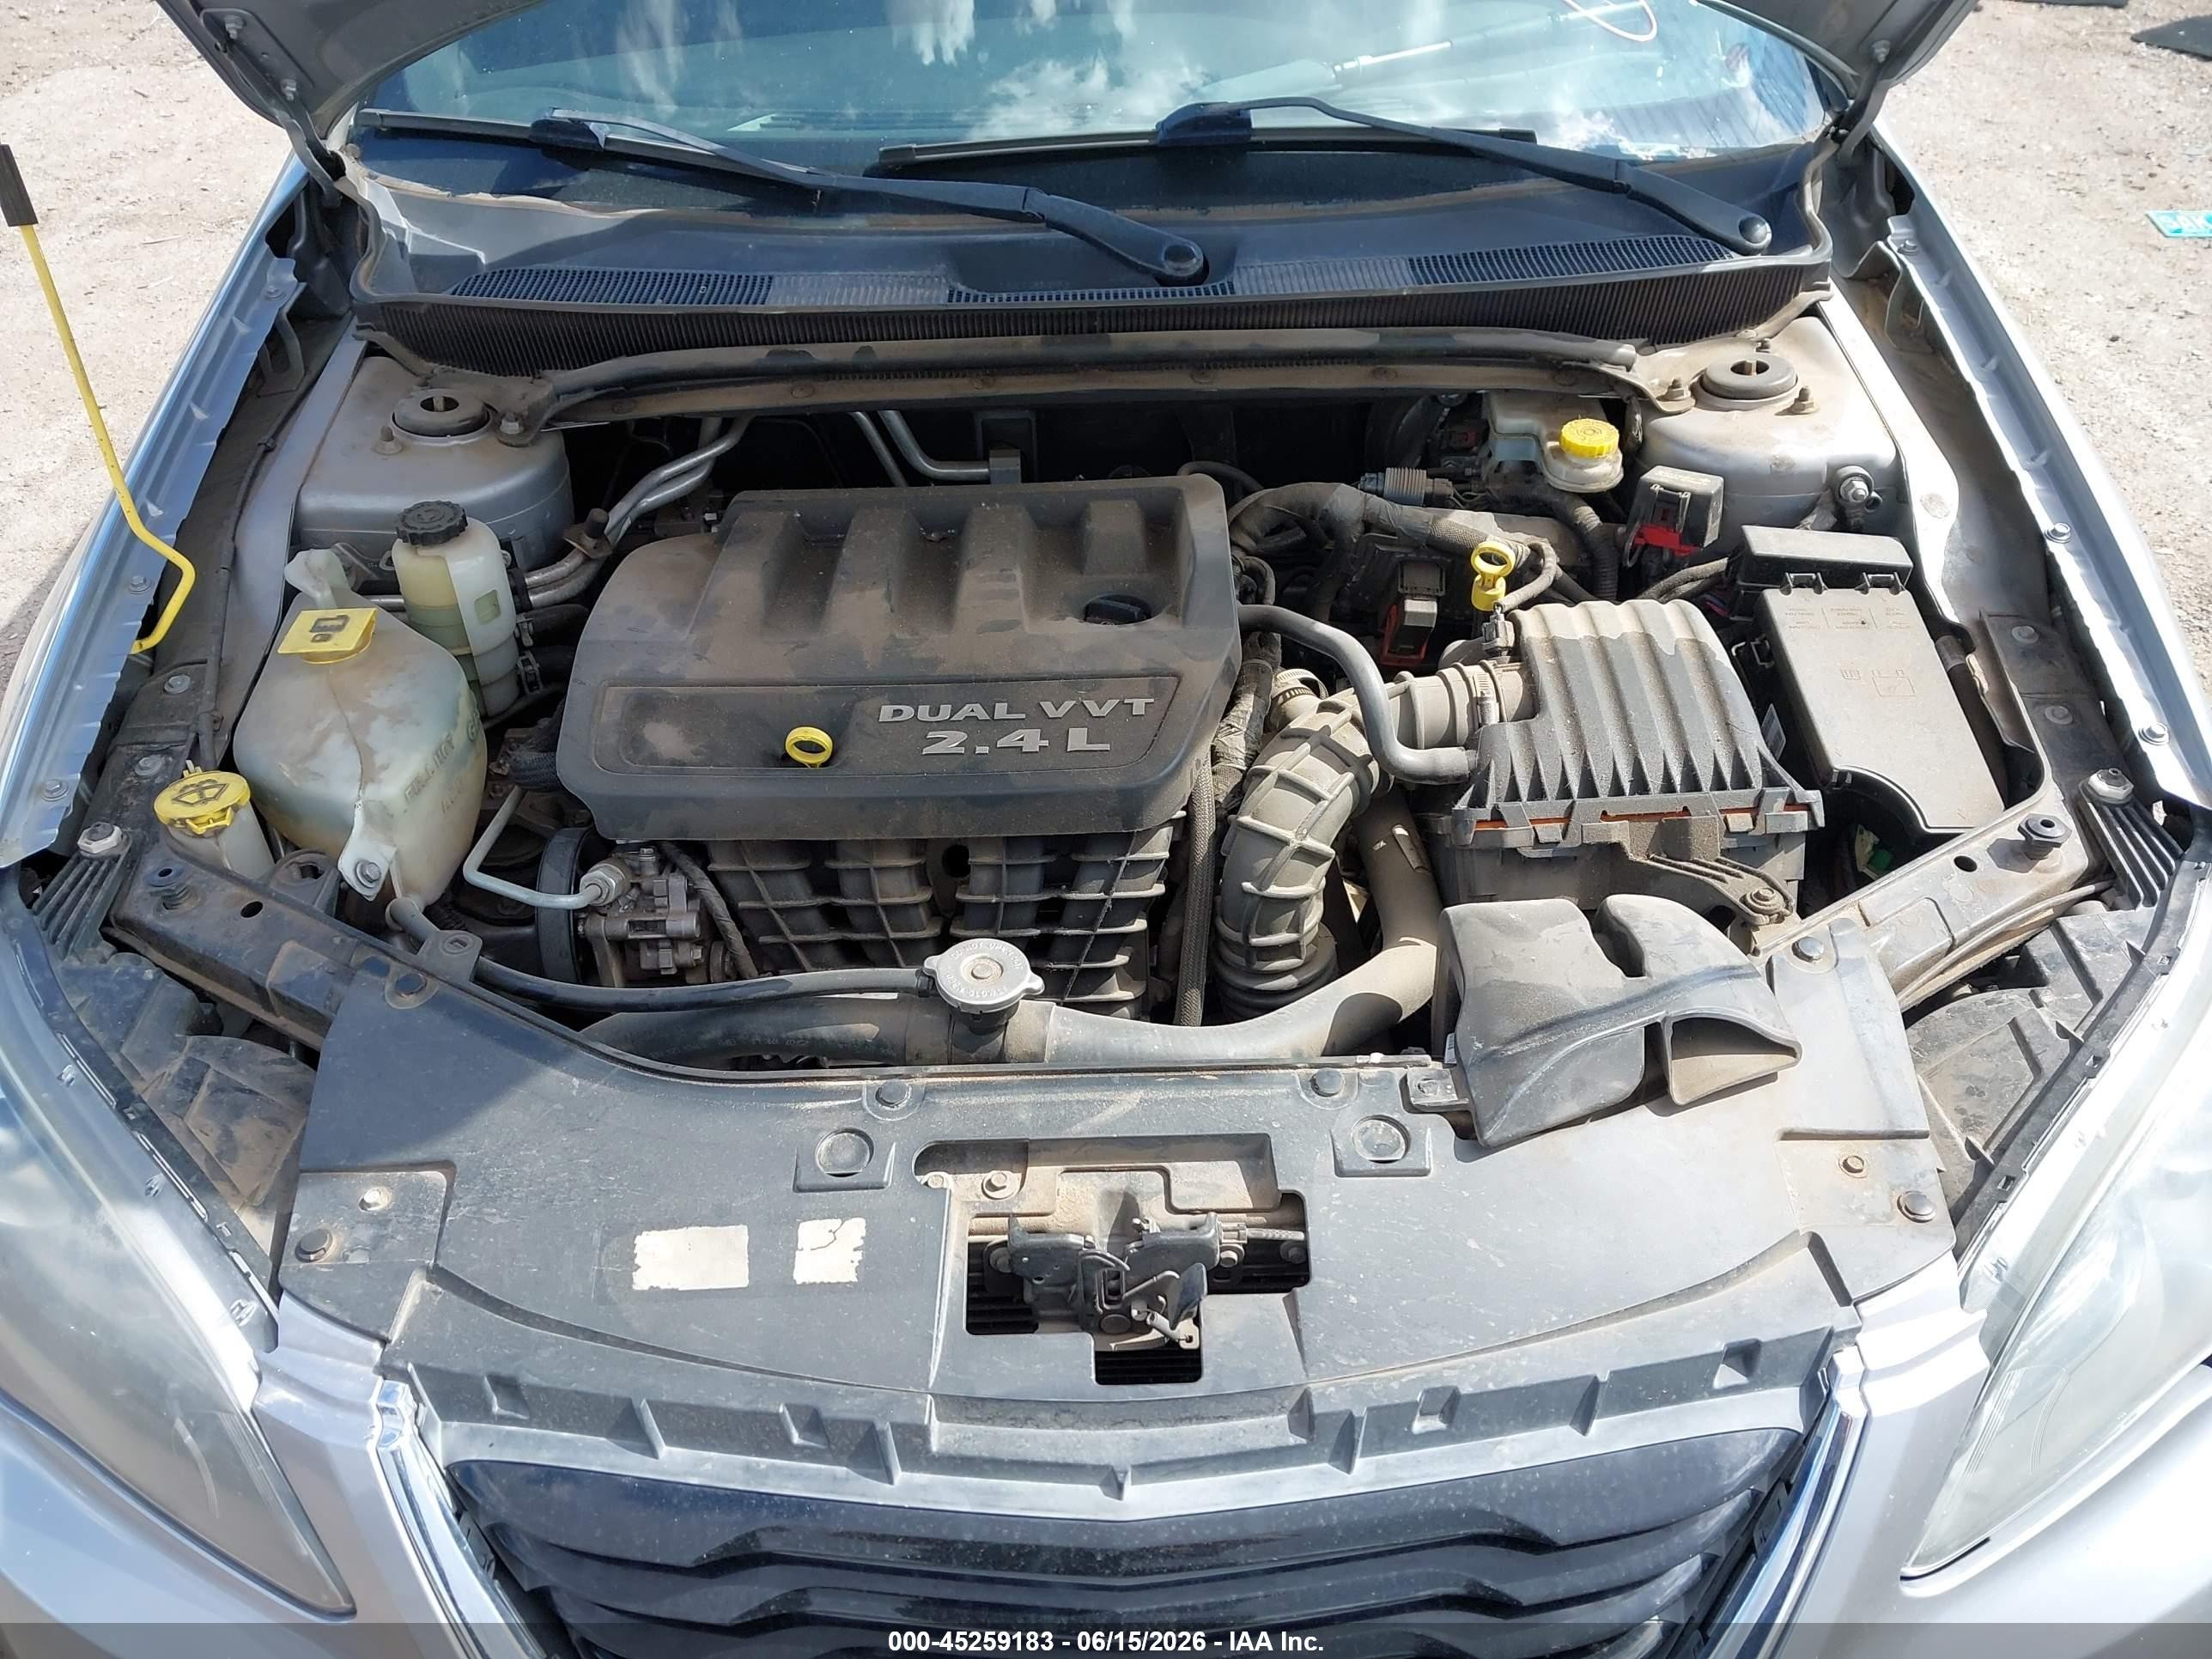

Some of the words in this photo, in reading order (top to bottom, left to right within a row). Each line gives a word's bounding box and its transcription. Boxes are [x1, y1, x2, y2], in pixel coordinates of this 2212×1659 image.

[878, 702, 1026, 723] DUAL
[1039, 698, 1155, 719] VVT
[921, 727, 1049, 755] 2.4
[1066, 727, 1110, 752] L
